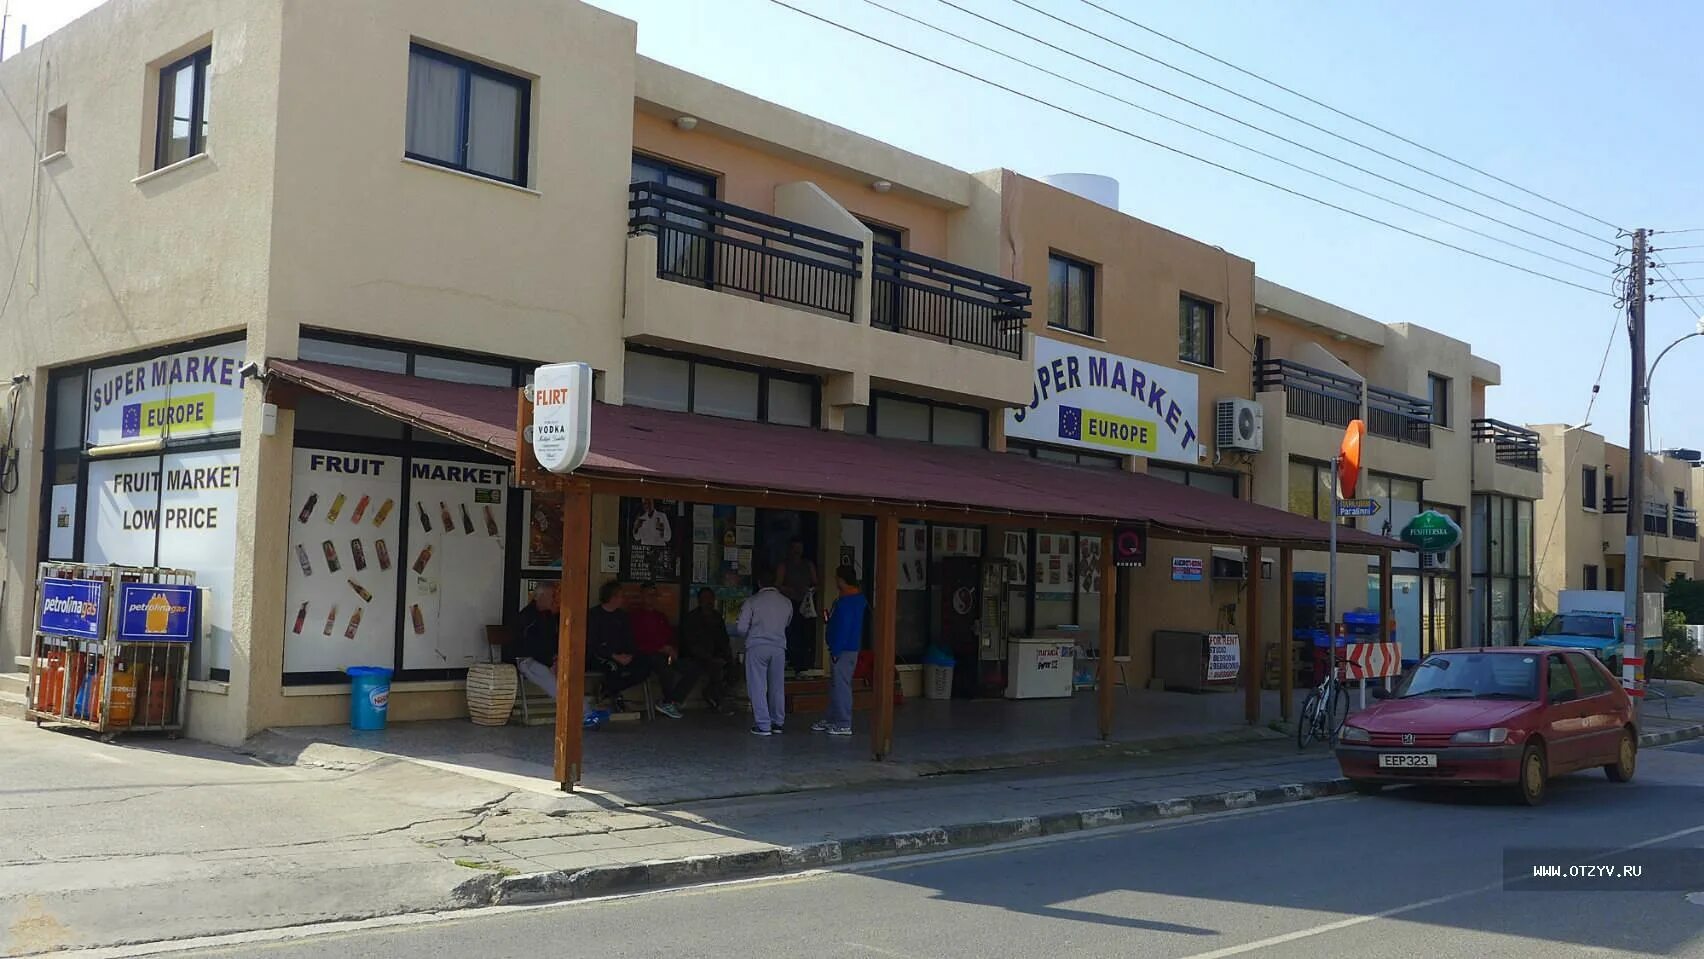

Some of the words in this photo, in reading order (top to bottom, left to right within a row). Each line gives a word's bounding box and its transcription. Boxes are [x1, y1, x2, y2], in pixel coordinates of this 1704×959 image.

[94, 366, 146, 412] SUPER
[536, 389, 568, 406] FLIRT
[148, 402, 204, 427] EUROPE
[1088, 356, 1196, 450] MARKET
[538, 425, 565, 434] VODKA
[1088, 418, 1148, 444] EUROPE
[310, 454, 384, 476] FRUIT
[412, 463, 506, 485] MARKET
[114, 472, 160, 493] FRUIT
[123, 510, 159, 530] LOW
[165, 507, 217, 529] PRICE
[1210, 636, 1222, 645] FOR
[1223, 636, 1238, 645] RENT
